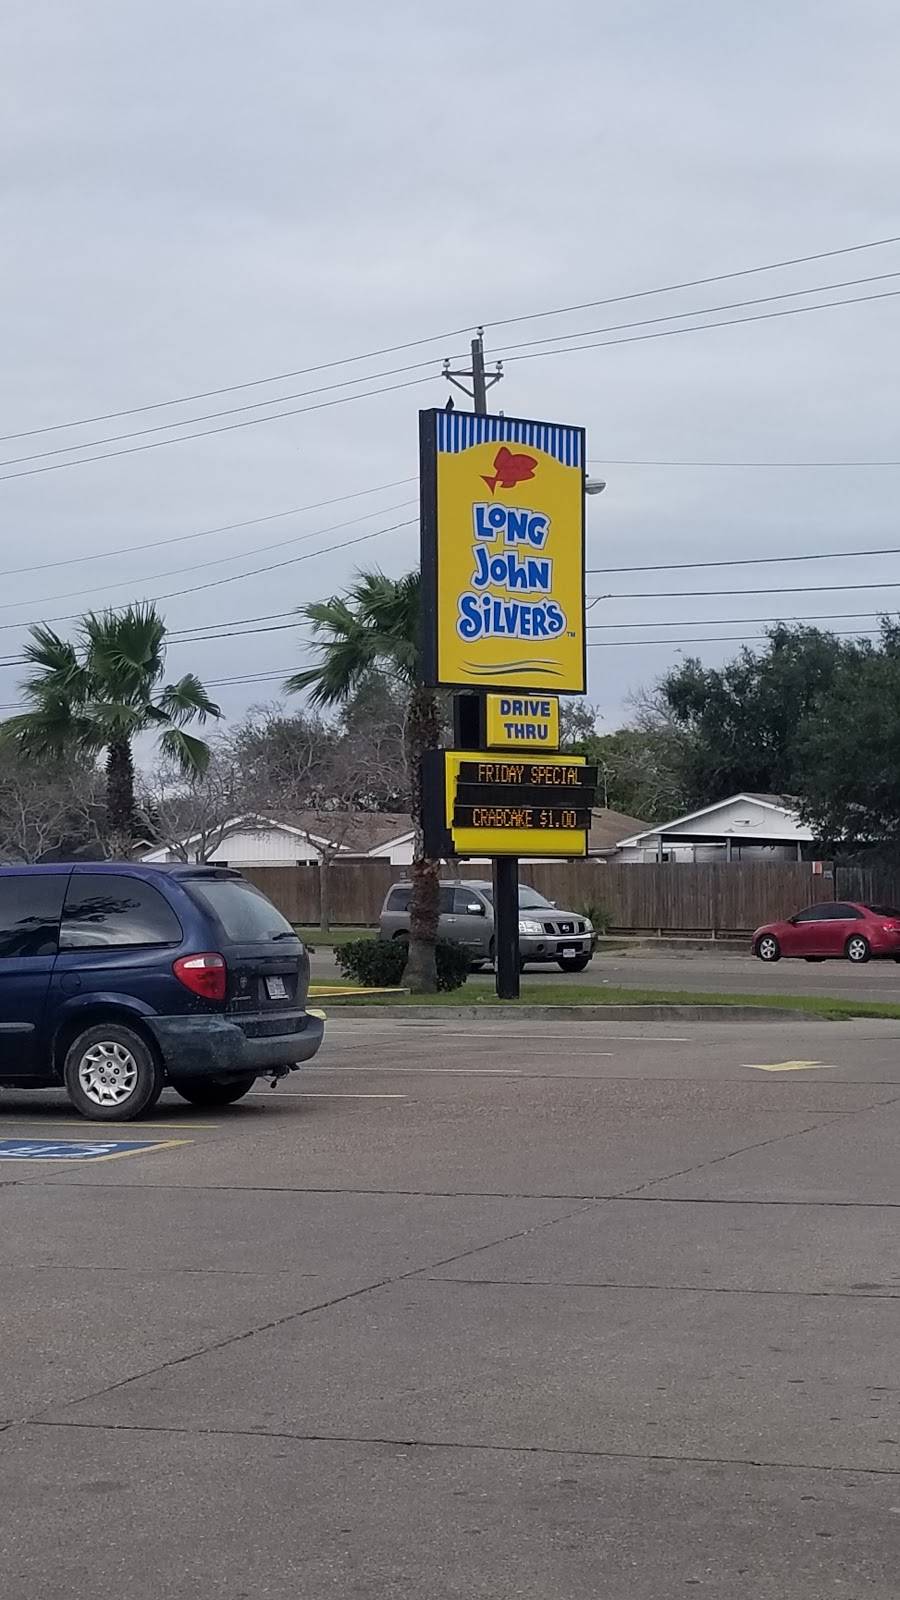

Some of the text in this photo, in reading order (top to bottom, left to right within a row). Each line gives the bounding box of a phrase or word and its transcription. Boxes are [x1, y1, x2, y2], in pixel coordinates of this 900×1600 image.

[475, 506, 548, 547] LONG
[500, 699, 551, 717] DRIVE
[504, 723, 548, 741] THRU
[478, 764, 582, 785] FRIDAY SPECIAL
[473, 808, 577, 828] CRABCAKE $1.00
